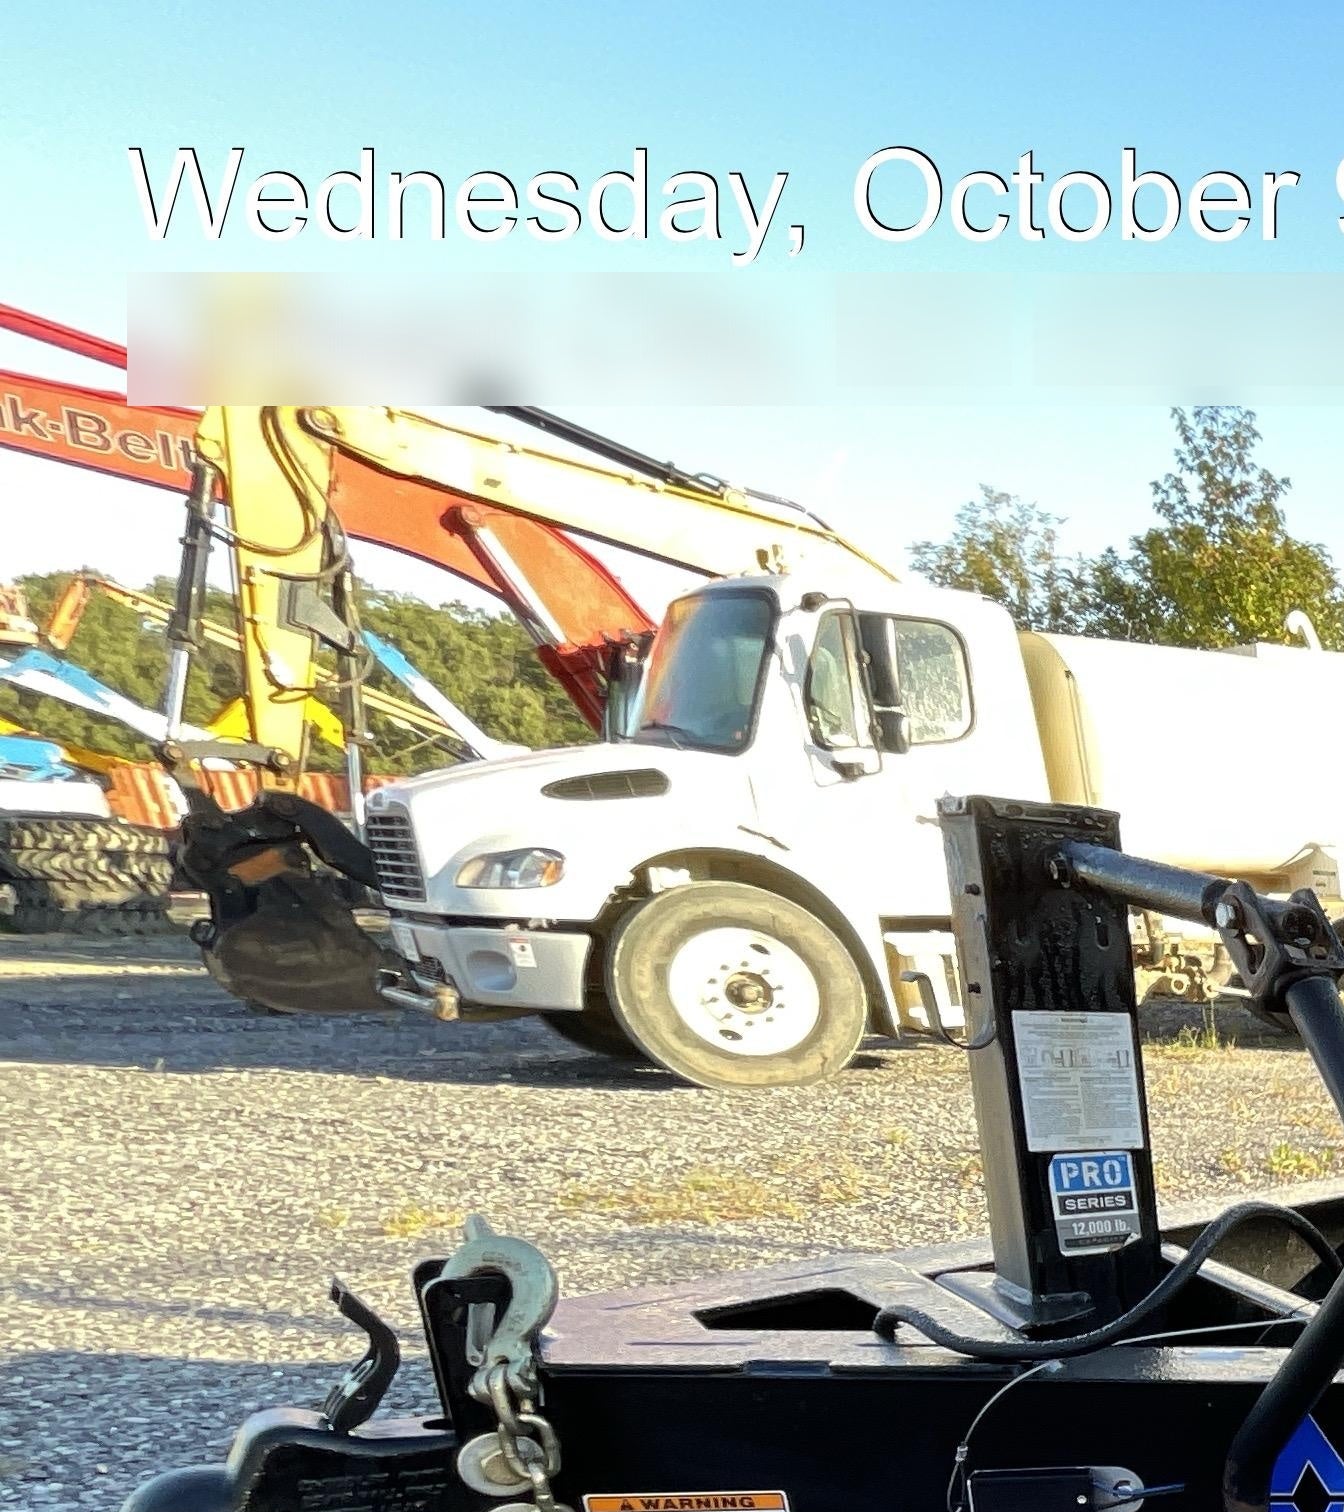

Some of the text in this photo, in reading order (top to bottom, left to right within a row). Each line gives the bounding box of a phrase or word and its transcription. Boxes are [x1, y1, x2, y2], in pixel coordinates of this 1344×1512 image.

[1060, 1159, 1122, 1189] PRO
[1064, 1195, 1127, 1211] SERIES
[1071, 1219, 1132, 1236] 12,000 lb.
[639, 1497, 756, 1510] WARNING
